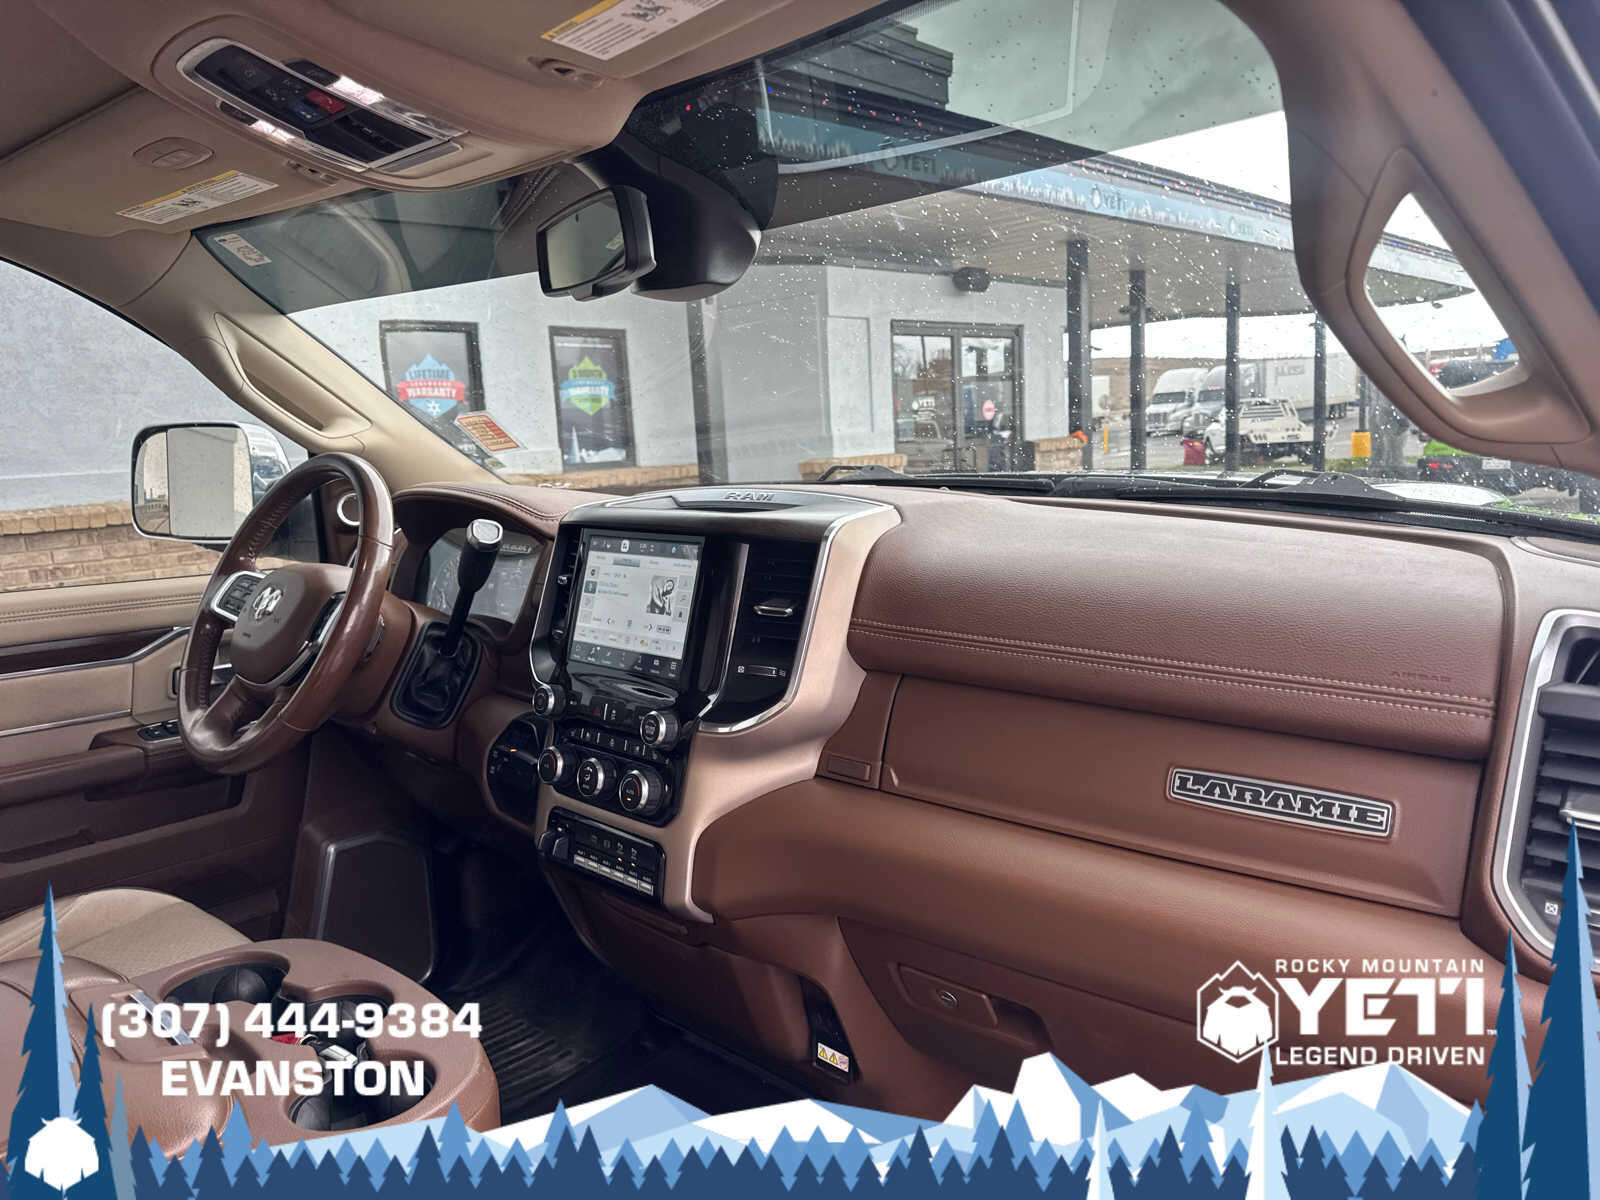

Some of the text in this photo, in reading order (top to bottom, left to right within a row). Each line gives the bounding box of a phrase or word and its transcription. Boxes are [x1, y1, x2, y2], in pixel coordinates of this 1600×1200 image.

[408, 368, 449, 380] LIFETIME
[406, 386, 457, 399] WARRANTY
[724, 491, 775, 502] RAM
[1173, 773, 1389, 830] LARAMIE
